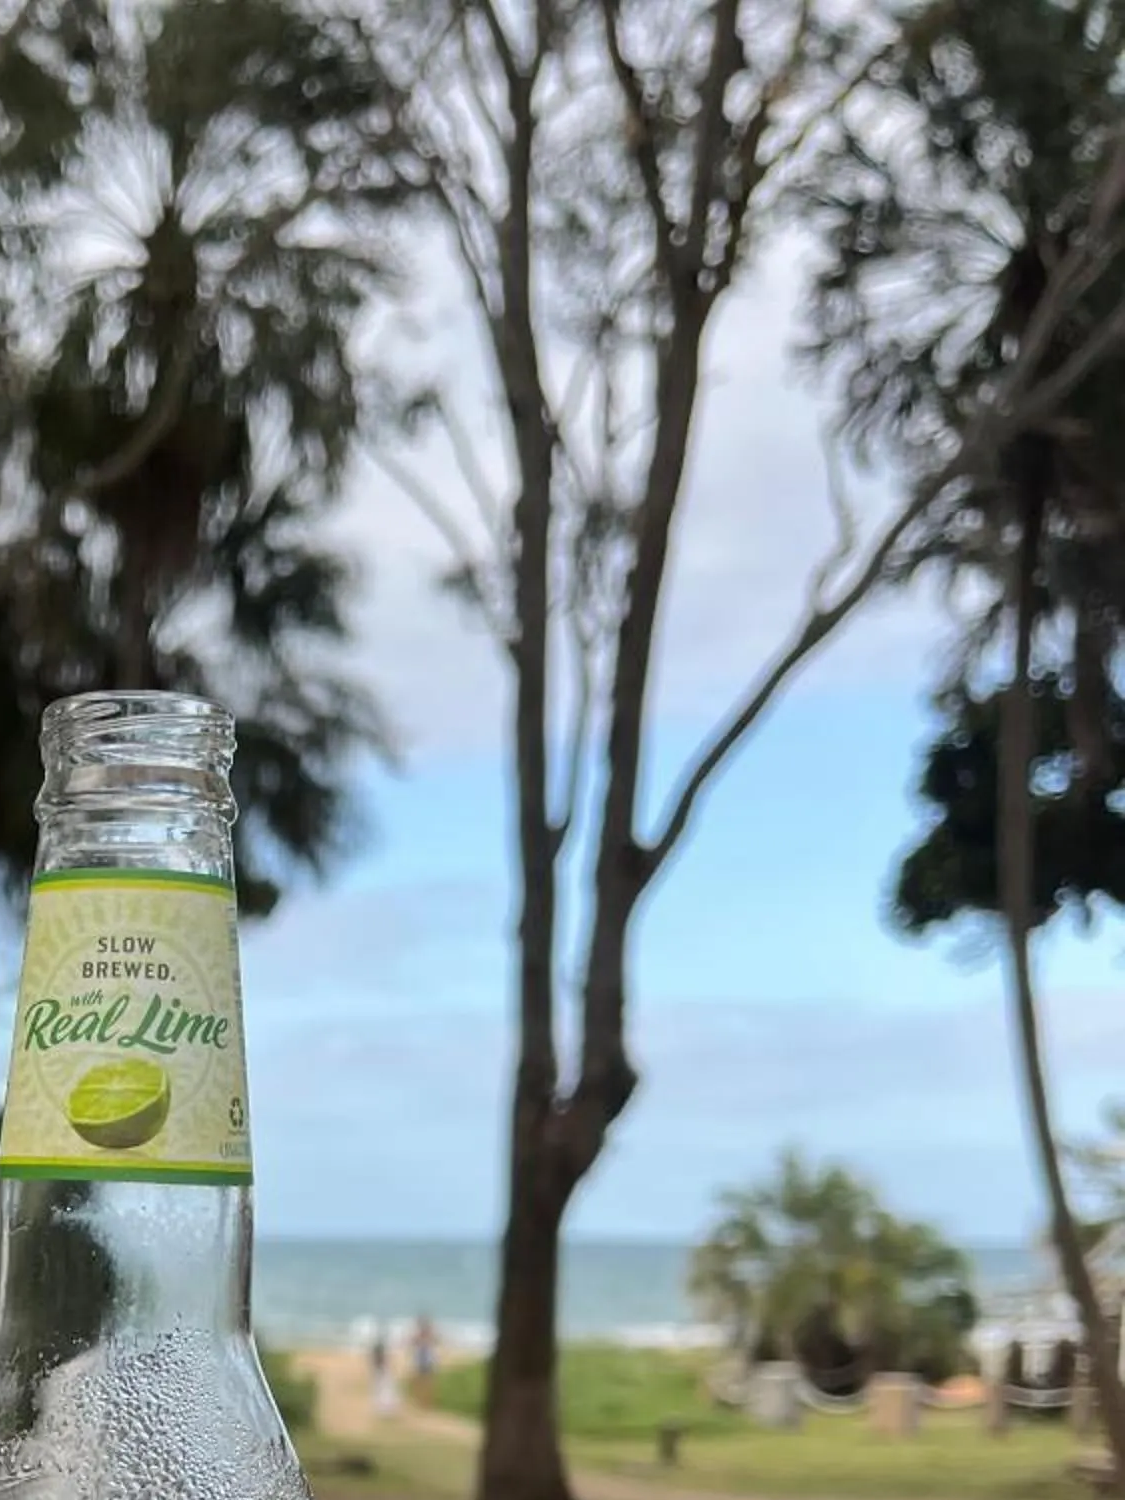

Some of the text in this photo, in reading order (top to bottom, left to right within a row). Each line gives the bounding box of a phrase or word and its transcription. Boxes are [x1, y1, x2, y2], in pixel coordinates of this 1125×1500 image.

[97, 937, 156, 955] SLOW
[70, 989, 104, 1008] with
[24, 994, 228, 1054] Real Lime
